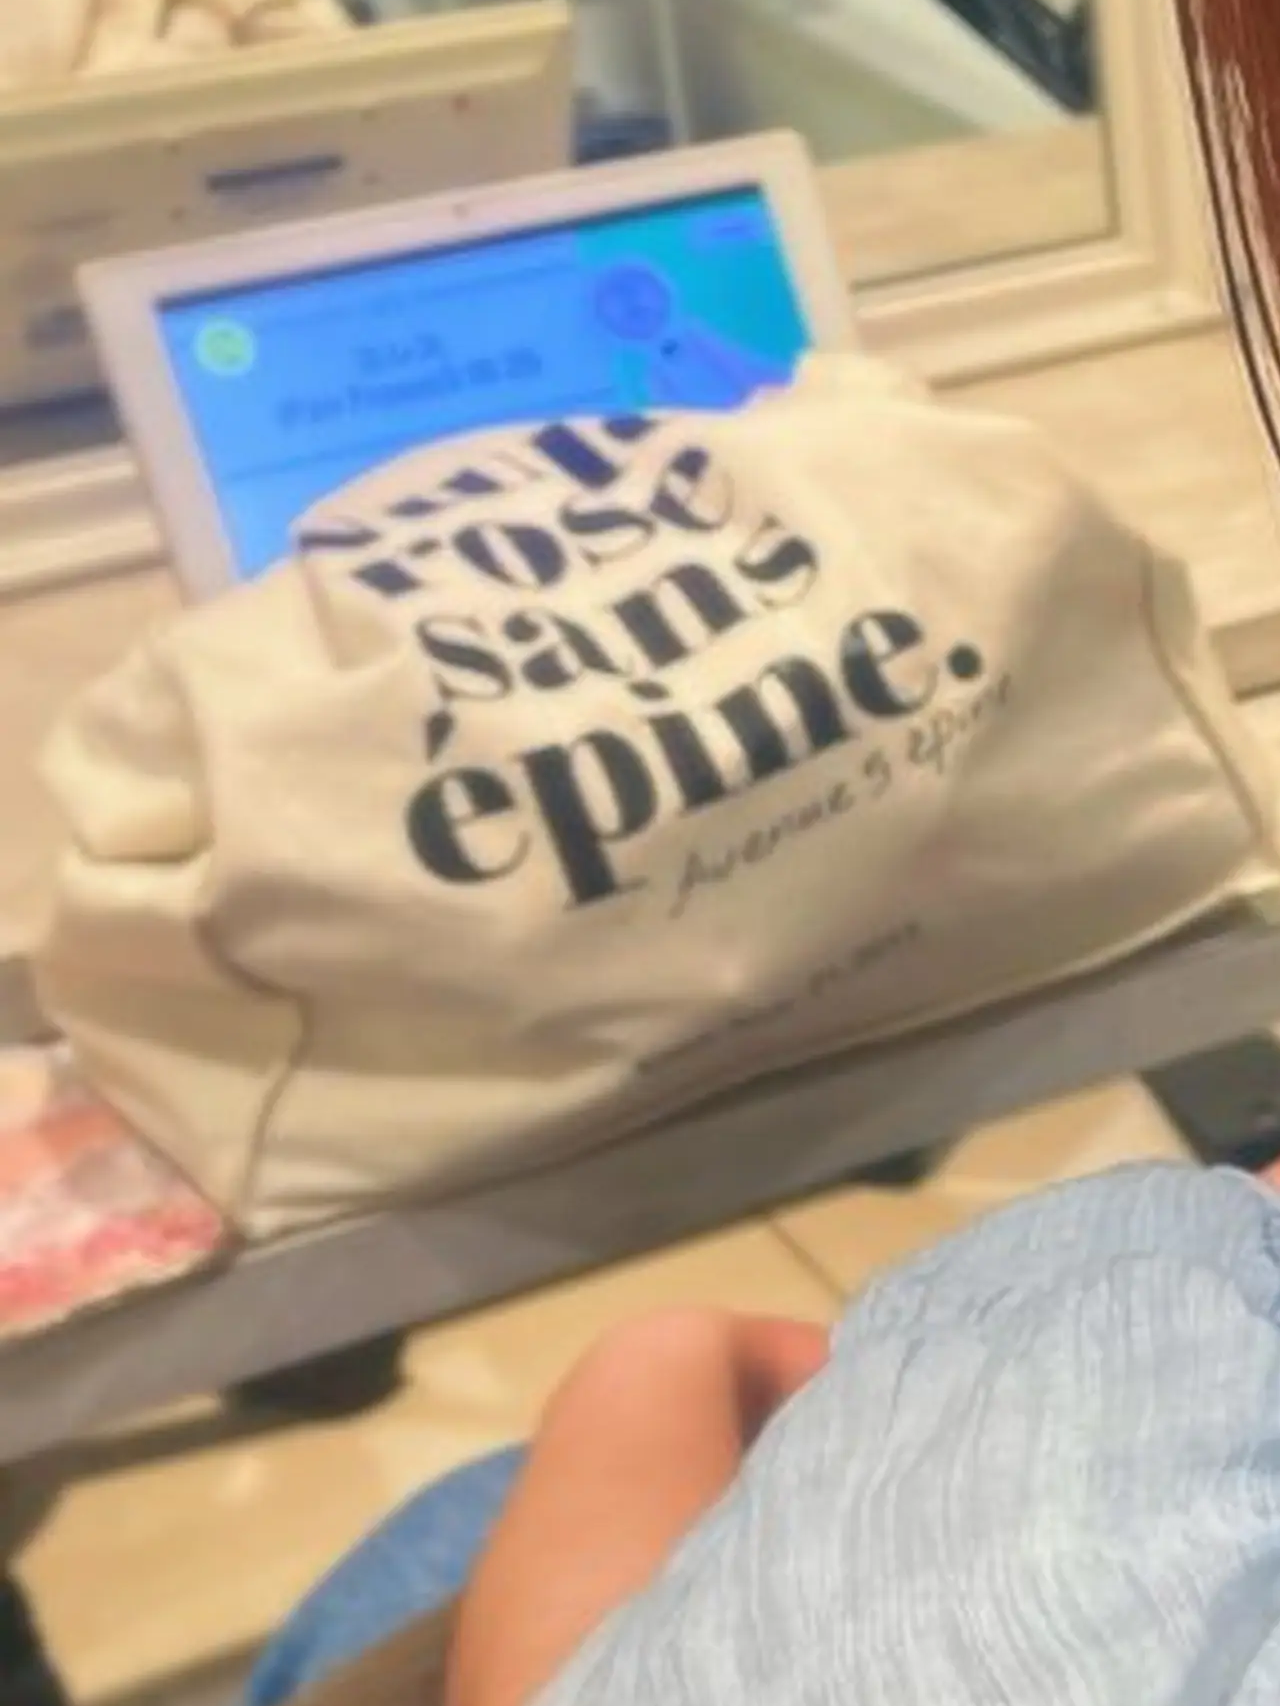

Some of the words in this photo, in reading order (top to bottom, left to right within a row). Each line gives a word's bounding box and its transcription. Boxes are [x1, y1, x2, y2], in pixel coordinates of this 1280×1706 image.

[351, 445, 737, 599] rose
[414, 515, 820, 701] sans
[404, 609, 984, 910] épine.
